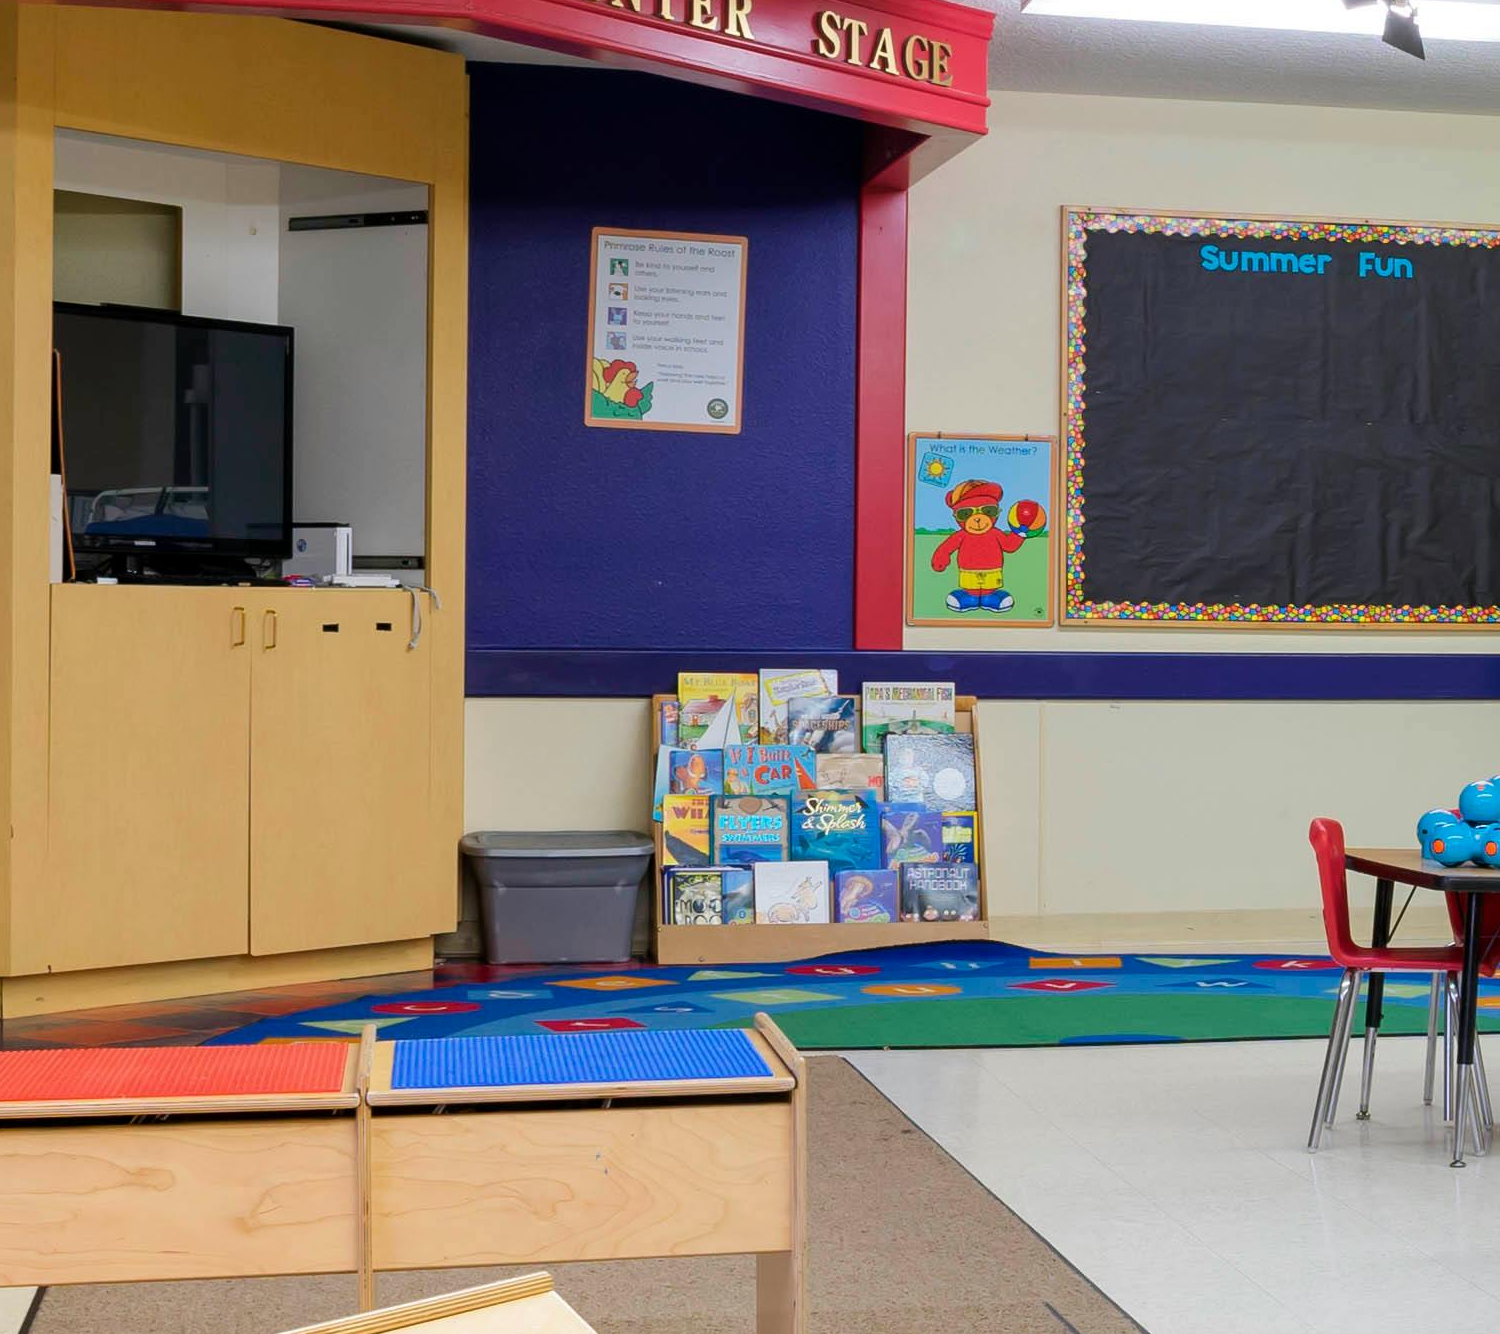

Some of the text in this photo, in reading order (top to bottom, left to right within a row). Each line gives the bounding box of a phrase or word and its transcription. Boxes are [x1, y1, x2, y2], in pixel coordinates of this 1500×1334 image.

[814, 10, 954, 87] STAGE
[650, 243, 674, 254] Rules
[677, 244, 686, 255] of
[1200, 244, 1413, 278] Summer Fun
[930, 443, 1037, 456] What is the Weather?
[754, 765, 792, 785] CAR
[803, 798, 862, 816] Shimmer
[718, 815, 782, 830] FLYERS
[802, 814, 866, 835] & Splash
[907, 867, 969, 879] ASTRONAUT
[910, 880, 967, 891] HANDBOOK
